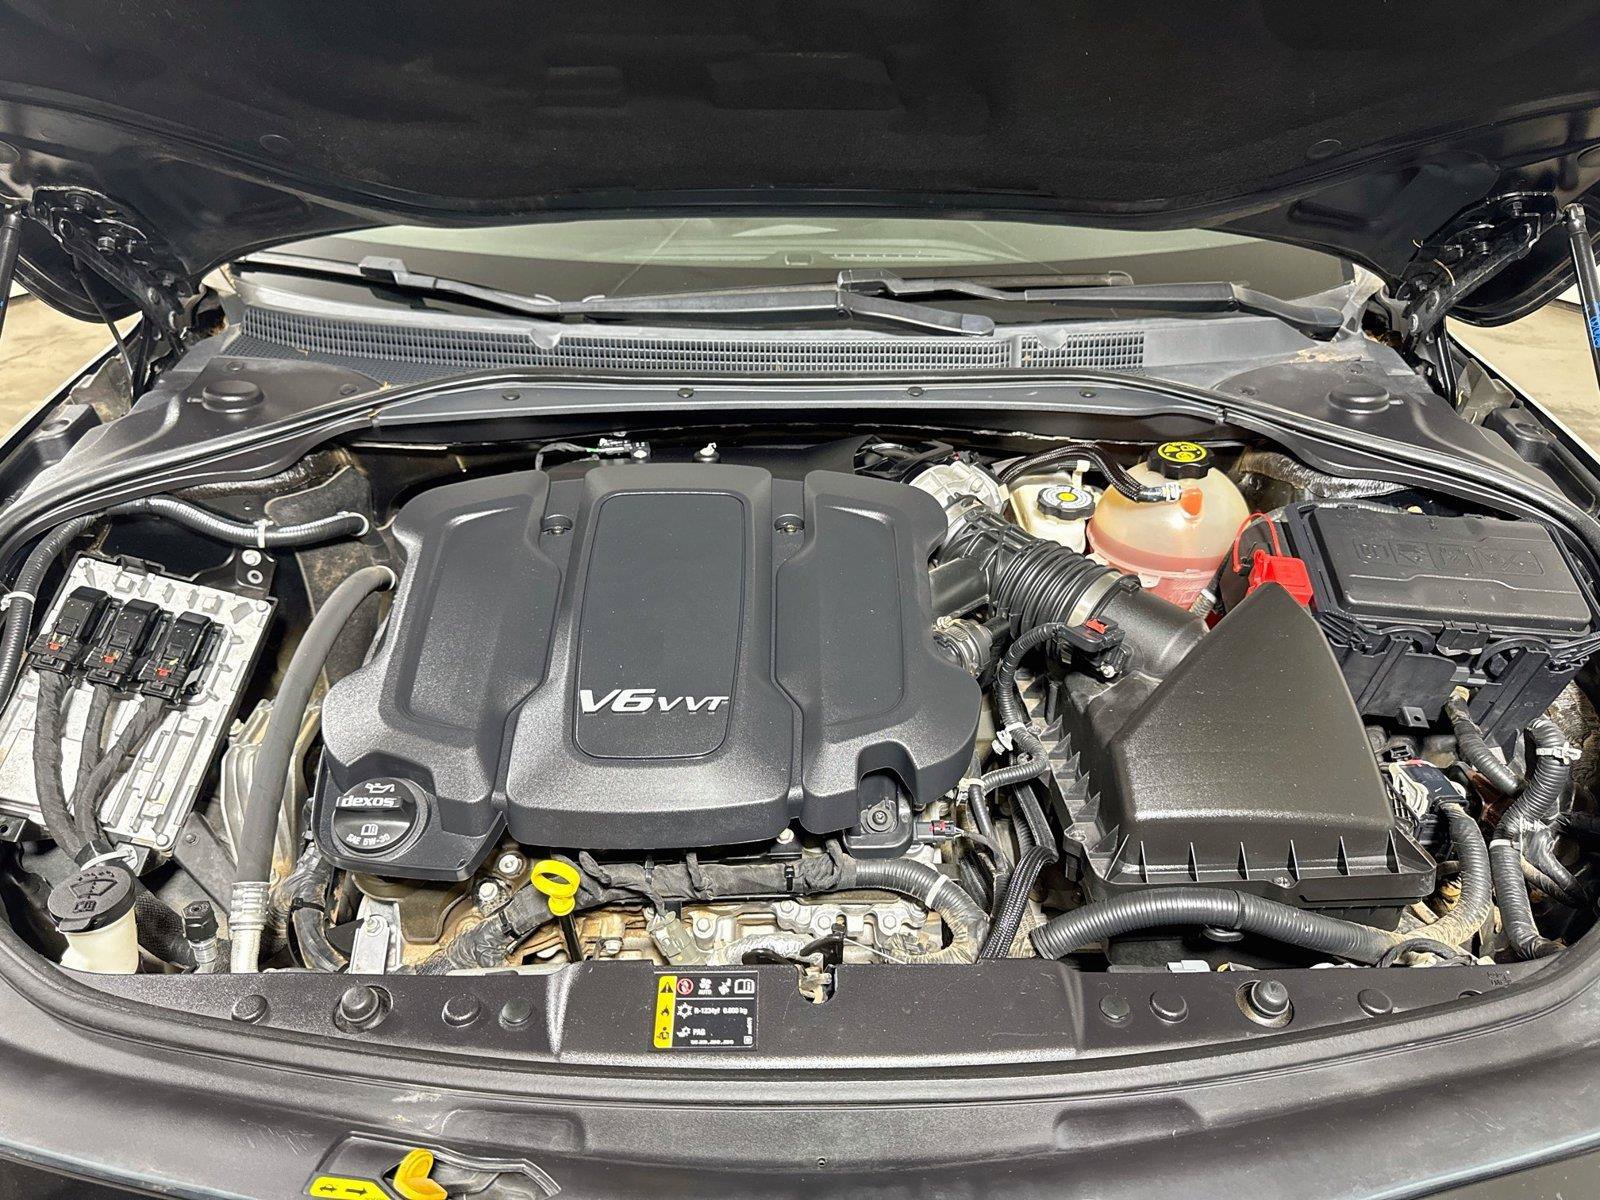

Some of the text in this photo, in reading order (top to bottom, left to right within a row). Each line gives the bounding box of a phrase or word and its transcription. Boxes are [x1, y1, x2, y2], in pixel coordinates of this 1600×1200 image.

[580, 688, 729, 713] V6 VVT
[341, 795, 397, 807] dexos
[346, 833, 361, 845] SAE
